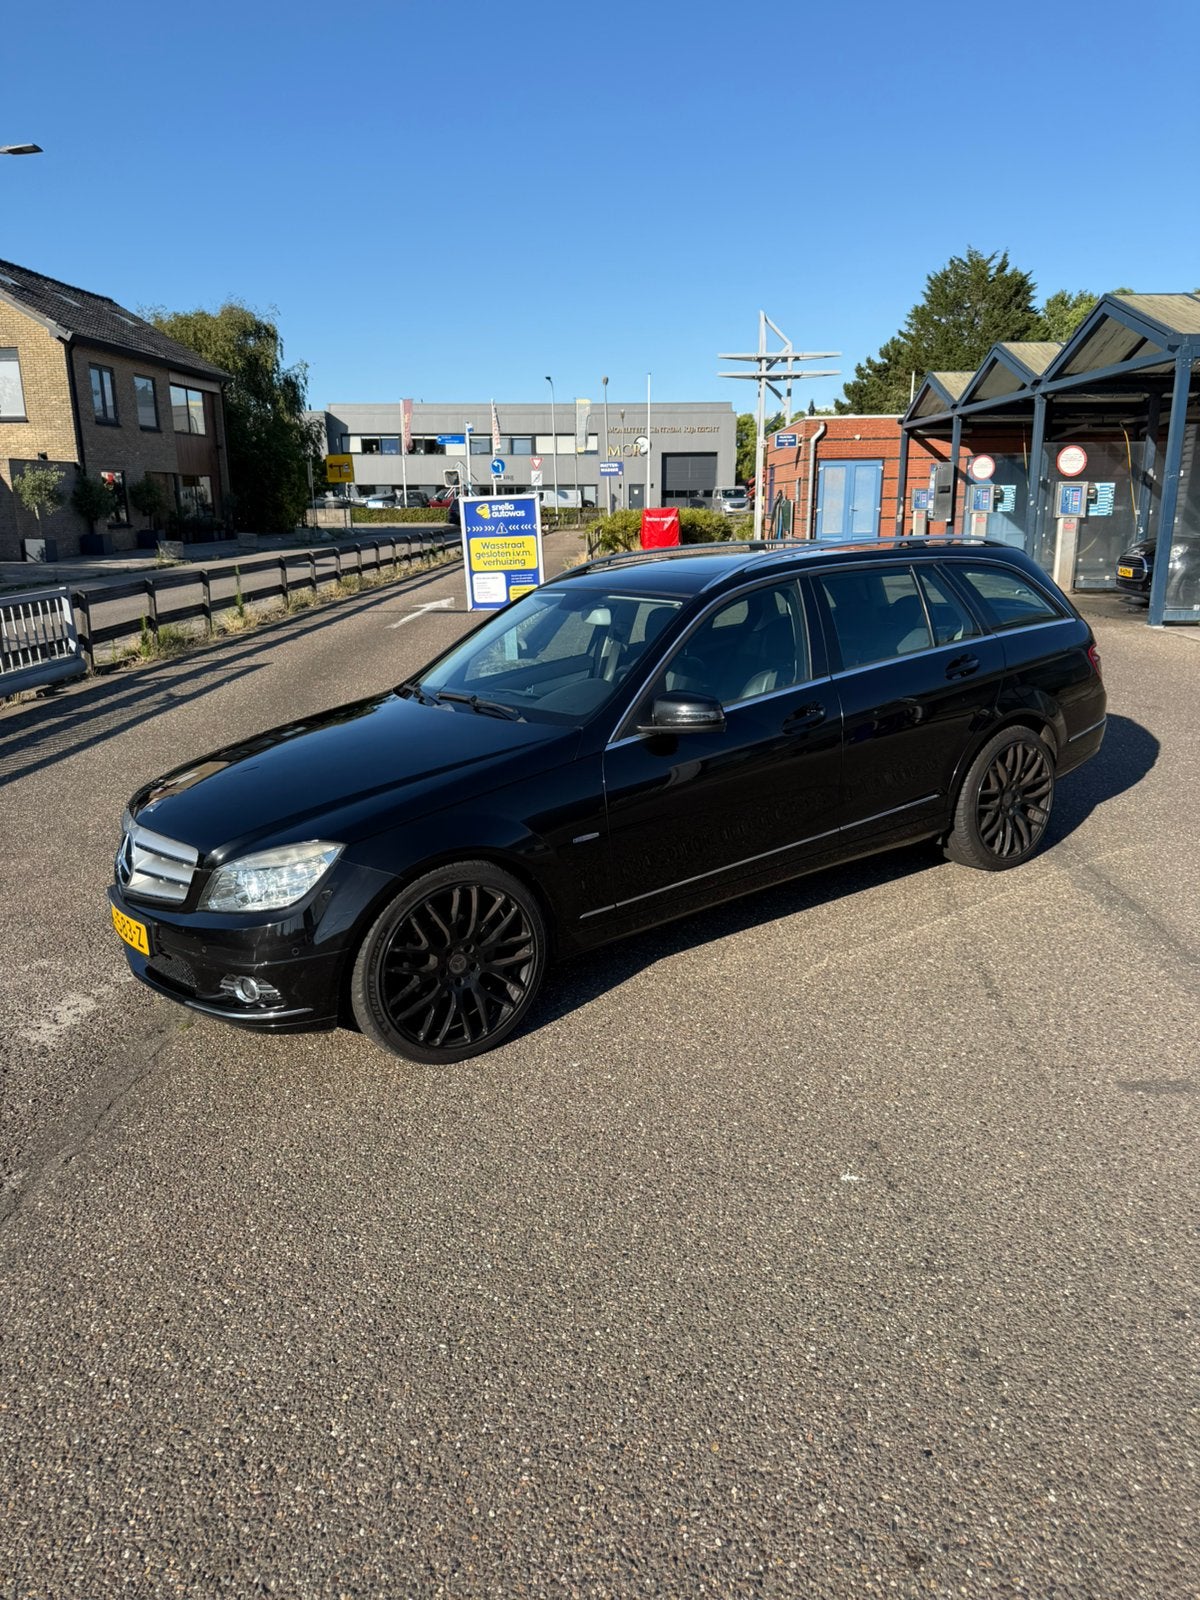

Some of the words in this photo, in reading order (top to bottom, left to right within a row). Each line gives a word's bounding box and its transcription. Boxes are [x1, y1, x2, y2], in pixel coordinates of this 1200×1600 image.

[491, 502, 515, 511] snella
[491, 510, 526, 518] autowas
[480, 541, 525, 550] Wasstraat
[475, 550, 511, 560] gesloten
[512, 549, 533, 557] i.v.m.
[482, 558, 526, 567] verhuizing
